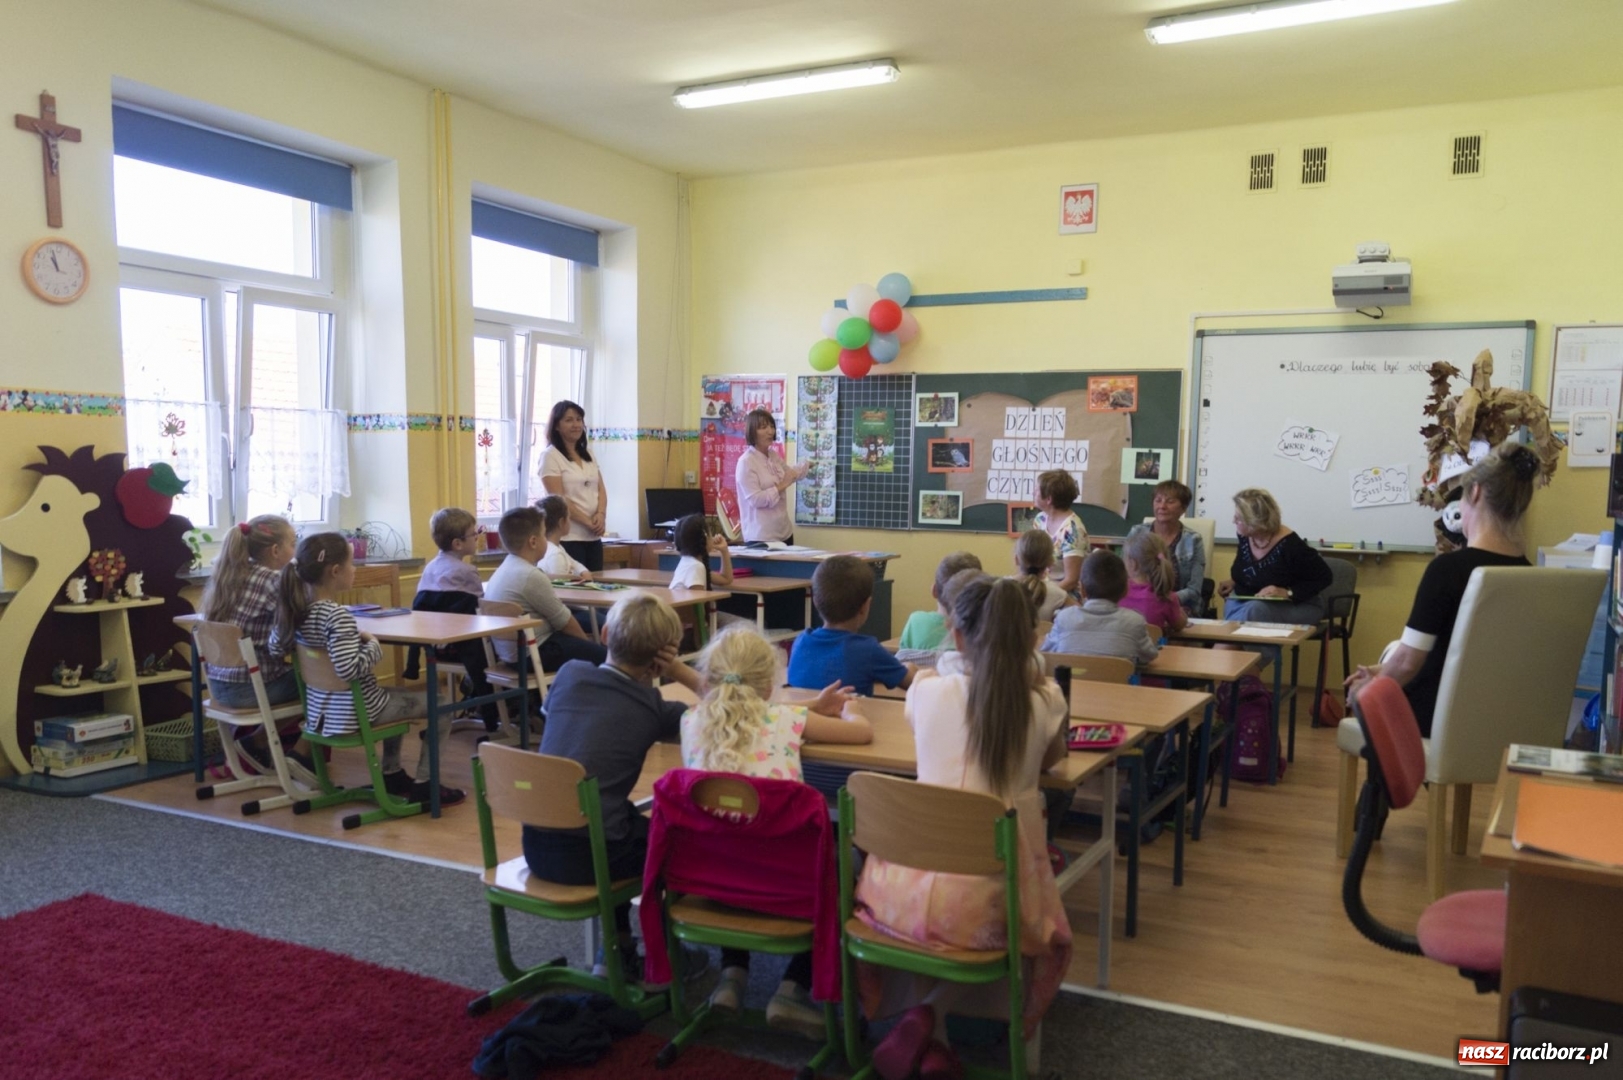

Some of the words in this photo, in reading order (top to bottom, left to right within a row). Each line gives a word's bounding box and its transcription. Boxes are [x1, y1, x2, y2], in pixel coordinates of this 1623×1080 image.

[1288, 360, 1343, 374] Dlaczego
[1351, 360, 1376, 372] lubię
[1006, 411, 1065, 432] DZIEŃ
[992, 443, 1088, 464] GŁOŚNEGO
